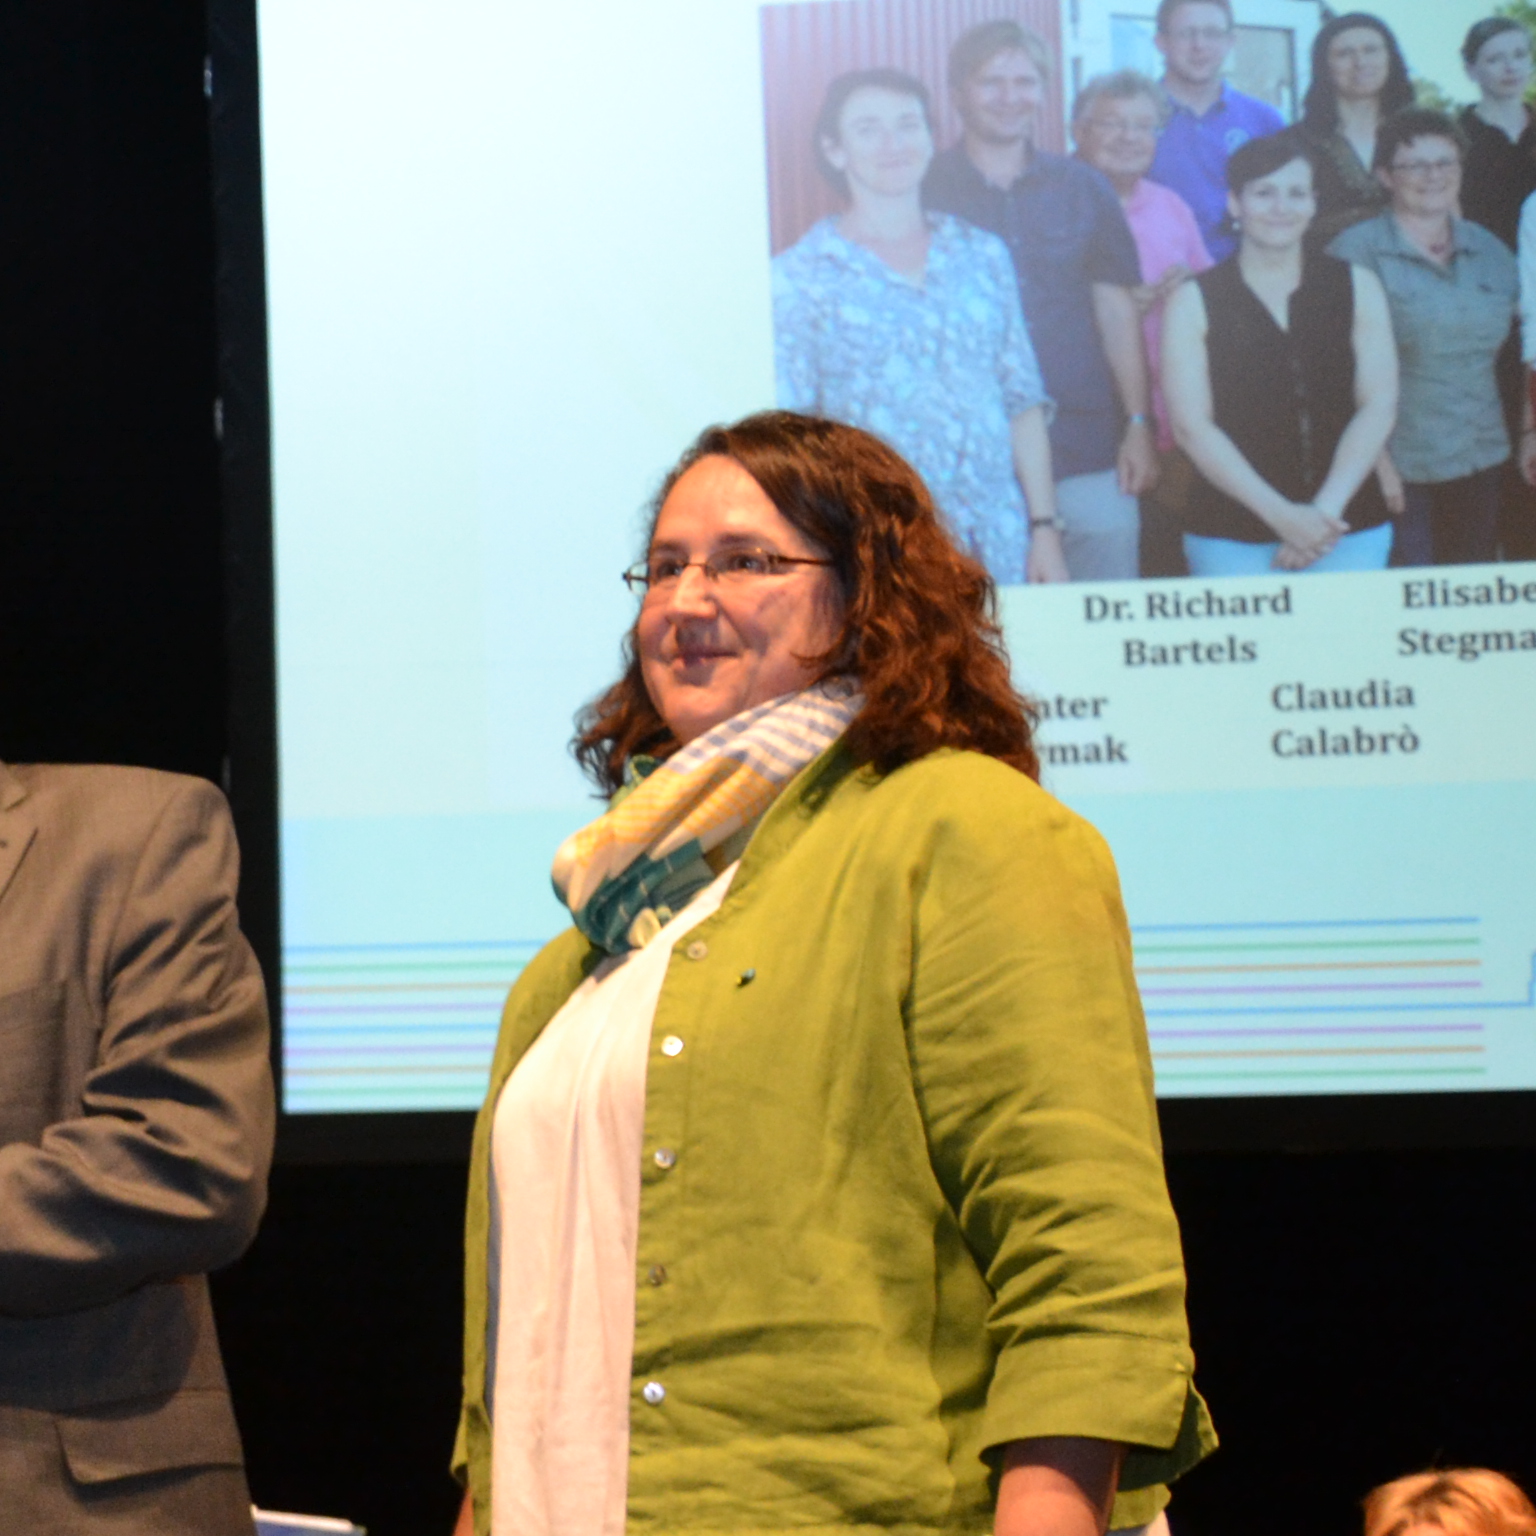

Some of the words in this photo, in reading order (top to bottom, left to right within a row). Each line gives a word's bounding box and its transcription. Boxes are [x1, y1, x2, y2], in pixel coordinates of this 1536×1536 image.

[1083, 594, 1134, 624] Dr.
[1146, 586, 1294, 621] Richard
[1123, 636, 1258, 667] Bartels
[1271, 680, 1416, 712] Claudia
[1271, 724, 1421, 758] Calabrò
